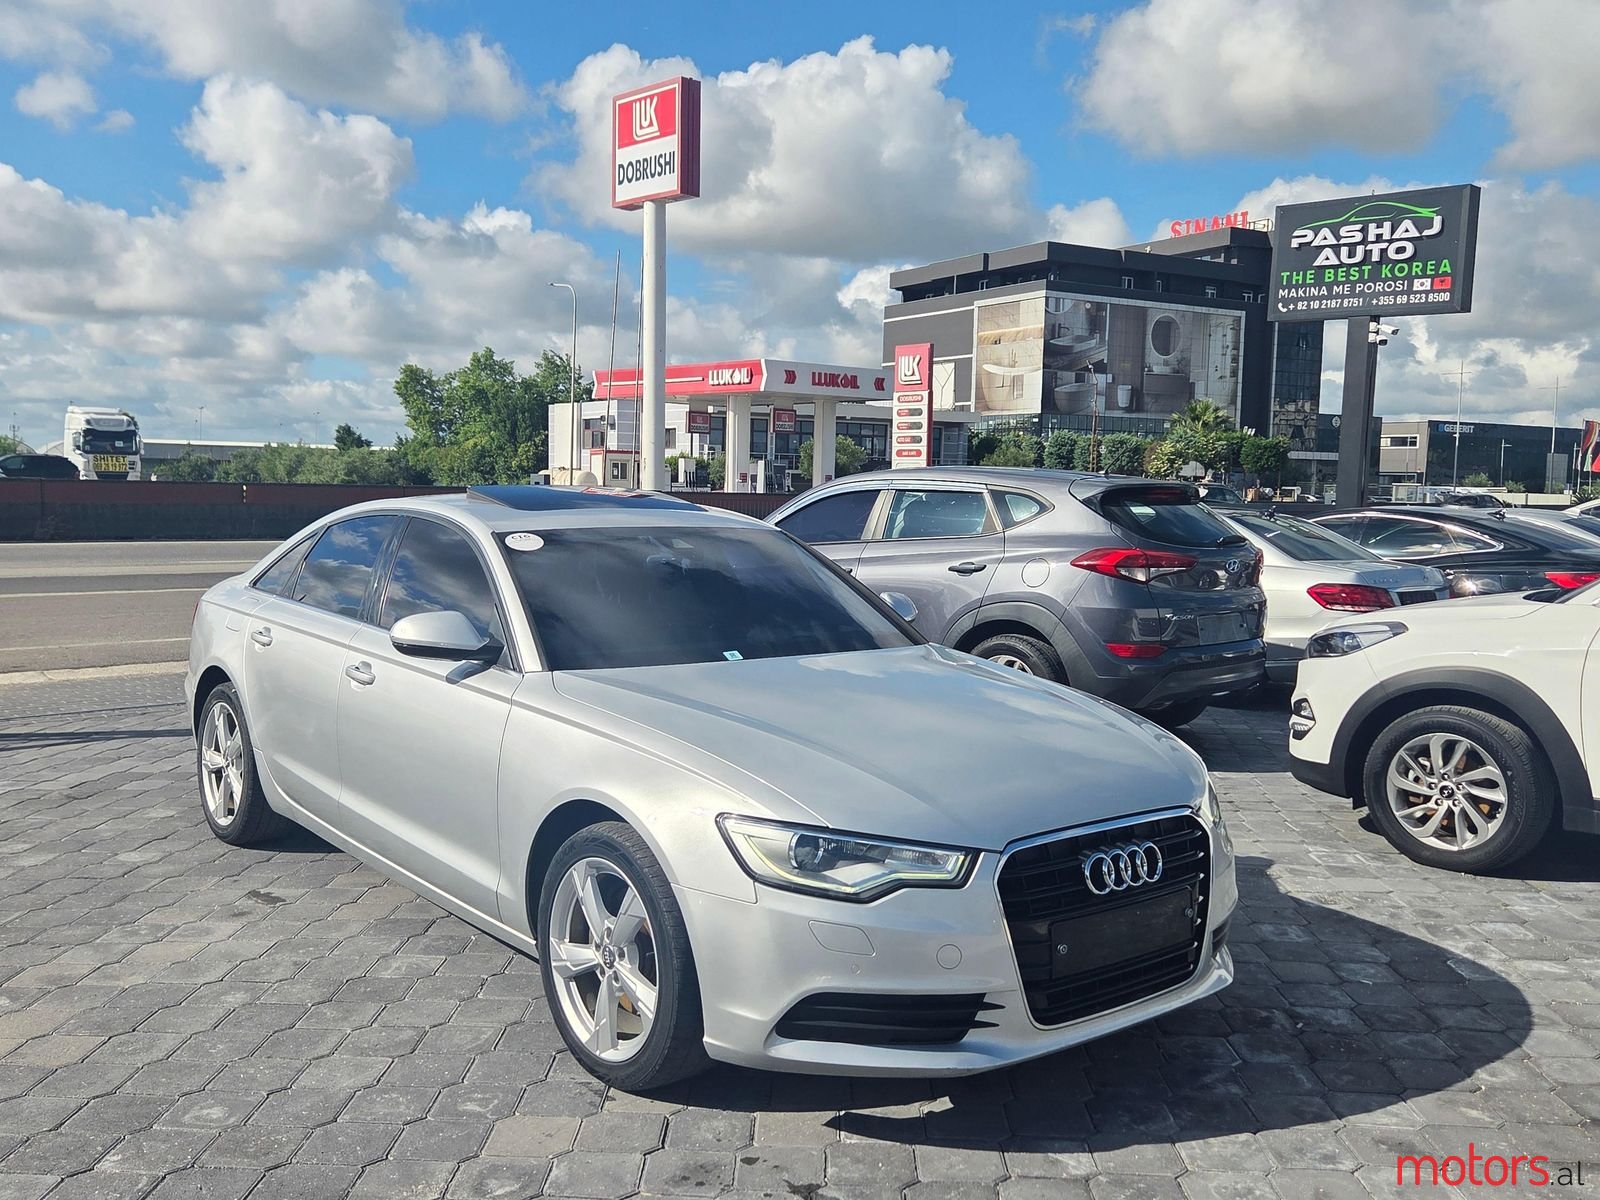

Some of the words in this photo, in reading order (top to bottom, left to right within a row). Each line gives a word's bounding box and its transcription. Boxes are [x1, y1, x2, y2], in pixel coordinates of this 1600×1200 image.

[617, 151, 675, 186] DOBRUSHI
[1291, 216, 1442, 248] PASHAJ
[1312, 241, 1415, 266] AUTO
[1281, 269, 1316, 286] THE
[1324, 264, 1373, 283] BEST
[1381, 258, 1453, 279] KOREA
[1278, 285, 1328, 299] MAKINA
[1332, 283, 1352, 296] ME
[1355, 279, 1408, 294] POROSI
[1297, 301, 1308, 311] 82
[1309, 300, 1320, 310] 10
[1321, 298, 1342, 309] 2187
[1343, 297, 1364, 308] 8751
[1371, 294, 1395, 306] +355
[1396, 294, 1408, 305] 69
[1409, 293, 1426, 304] 523
[1427, 291, 1451, 303] 8500
[93, 455, 128, 463] SHITET
